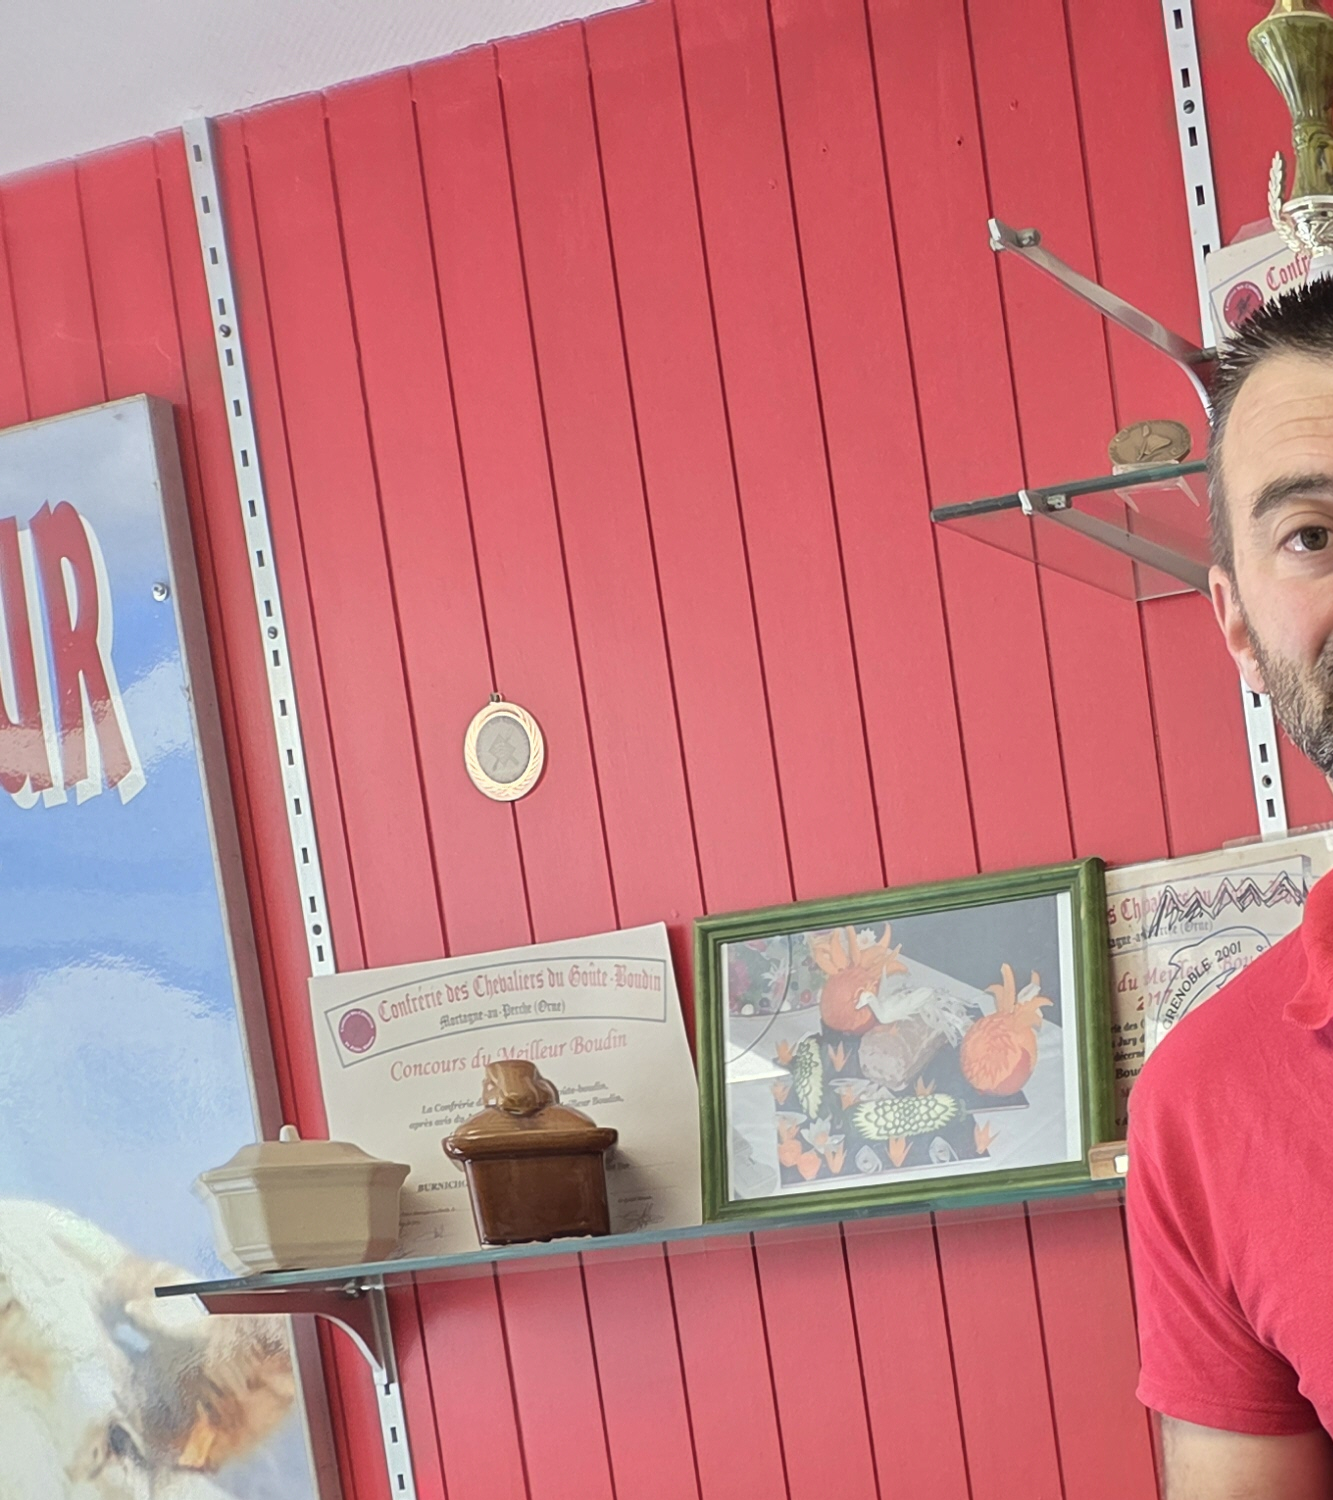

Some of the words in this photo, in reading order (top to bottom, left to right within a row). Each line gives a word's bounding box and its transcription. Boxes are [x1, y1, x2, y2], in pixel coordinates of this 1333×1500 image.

[1266, 250, 1312, 291] Confr
[378, 986, 443, 1023] Confrérie
[447, 979, 470, 1003] des
[473, 967, 544, 998] Chevaliers
[547, 967, 565, 988] du
[1117, 971, 1138, 993] du
[1162, 958, 1212, 1031] GRENOBLE
[1215, 941, 1242, 963] 2001
[534, 999, 566, 1014] (Orne)
[390, 1059, 467, 1082] Concours
[471, 1047, 491, 1070] du
[497, 1038, 567, 1062] Meilleur
[570, 1028, 628, 1055] Boudin
